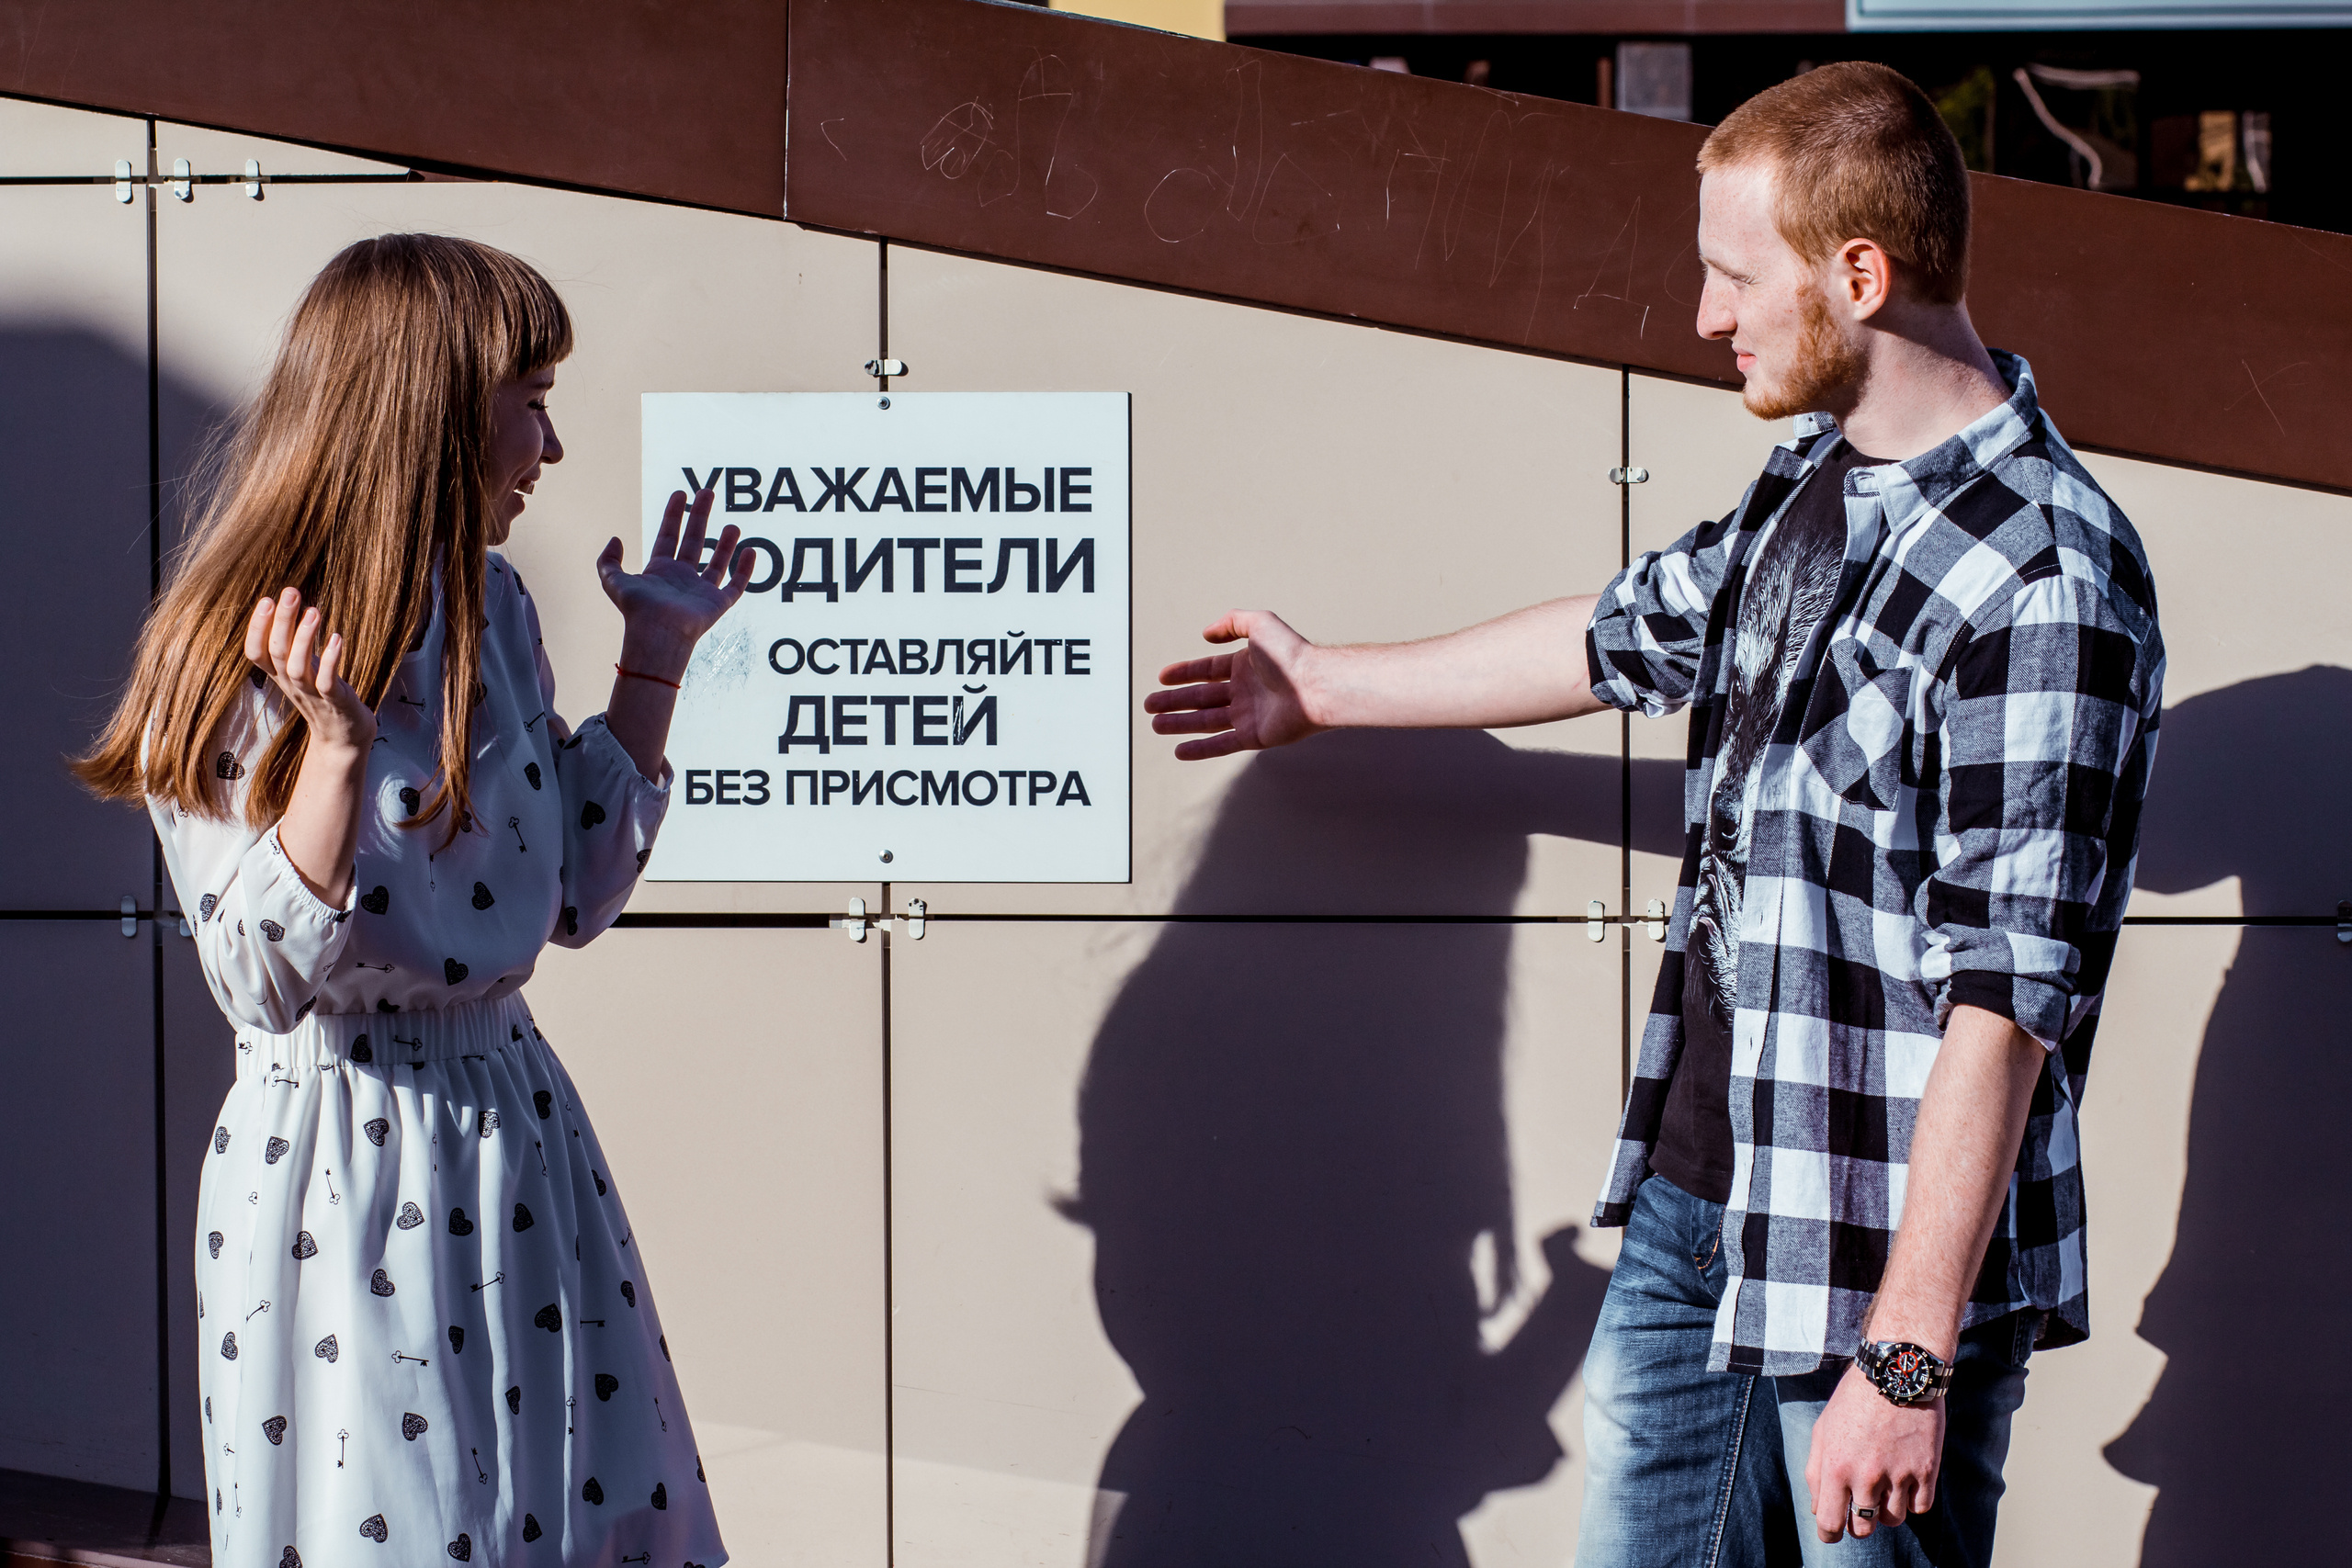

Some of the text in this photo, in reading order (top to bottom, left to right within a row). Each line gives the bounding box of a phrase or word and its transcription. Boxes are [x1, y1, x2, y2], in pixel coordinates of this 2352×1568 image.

[681, 467, 1092, 513] УВАЖАЕМЫЕ
[768, 630, 1091, 675] ОСТАВЛЯЙТЕ
[778, 683, 998, 754] ДЕТЕЙ
[685, 769, 1091, 807] БЕЗ ПРИСМОТРА
